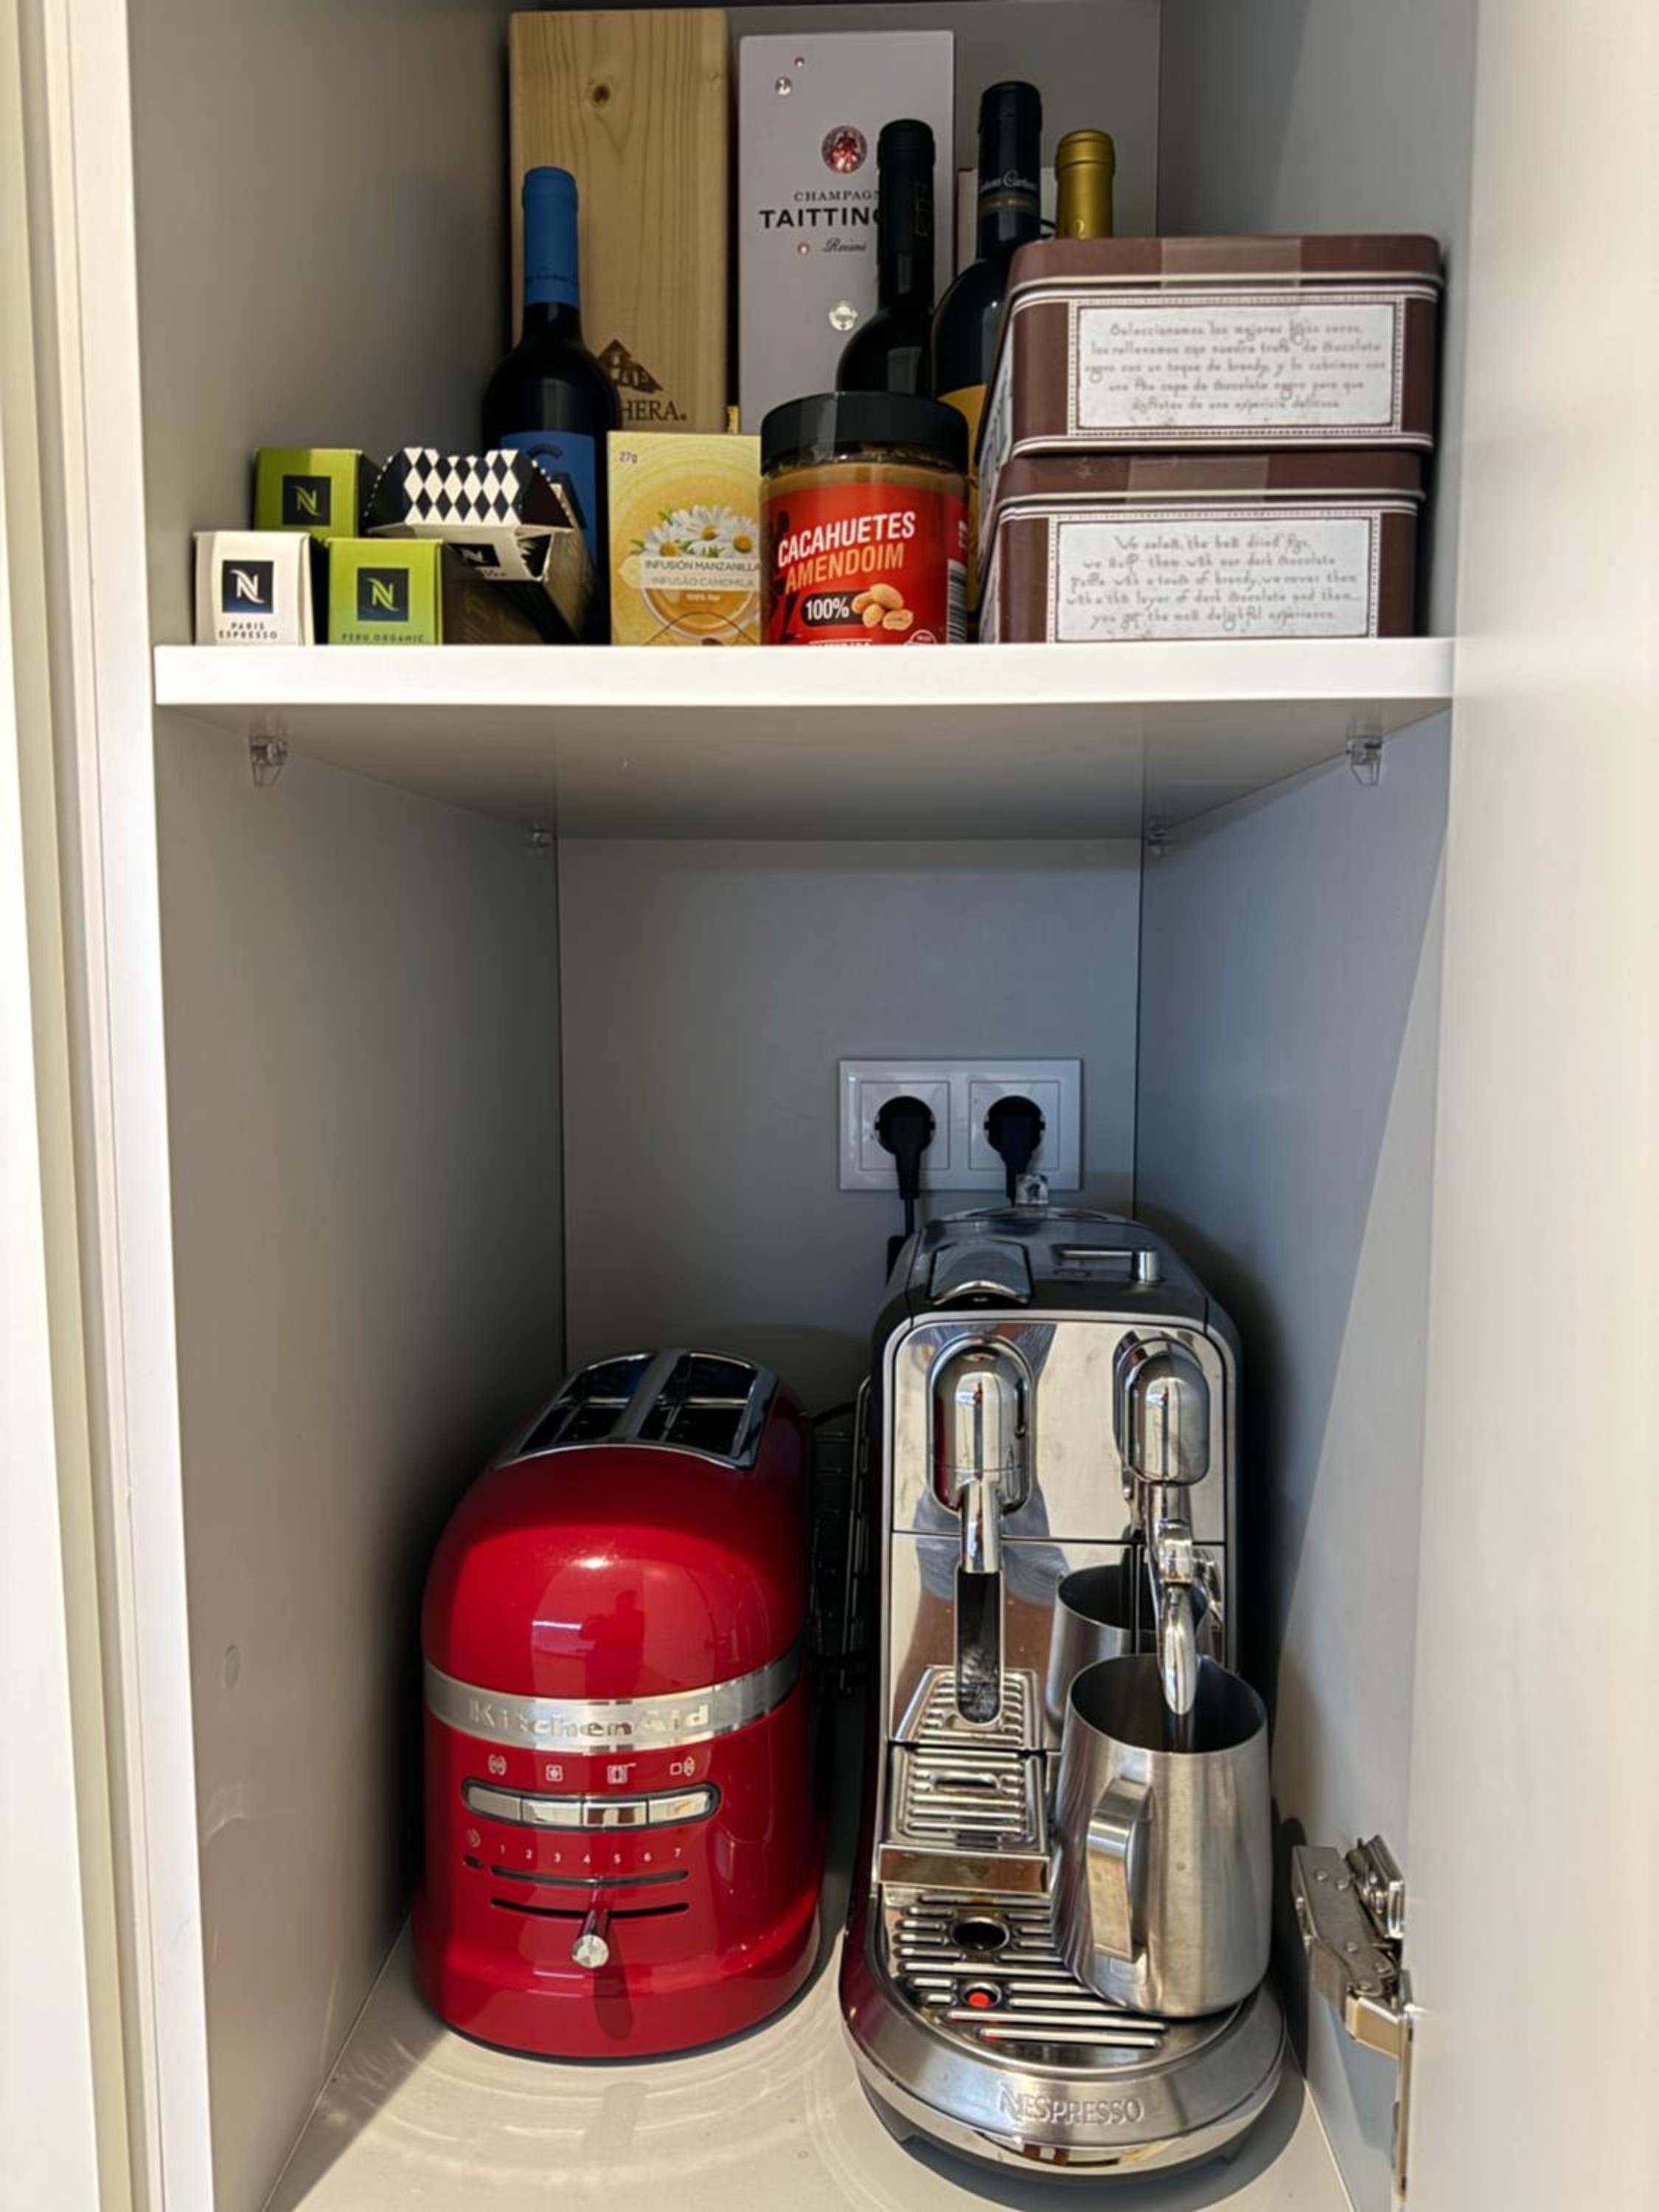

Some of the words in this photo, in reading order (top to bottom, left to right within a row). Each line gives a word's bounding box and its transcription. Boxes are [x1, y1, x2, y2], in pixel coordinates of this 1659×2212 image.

[619, 451, 638, 467] 27g
[778, 510, 917, 568] CACAHUETES
[785, 542, 905, 594] AMENDOIM
[805, 597, 850, 622] 100%
[219, 630, 278, 639] ESPRESSO
[231, 622, 265, 630] PARIS
[341, 633, 369, 642] PERU
[373, 633, 425, 643] ORGANIC
[470, 1698, 709, 1738] KitchenAid
[525, 1848, 533, 1859] 2
[554, 1852, 561, 1863] 3
[582, 1854, 591, 1864] 4
[613, 1854, 622, 1864] 5
[644, 1851, 652, 1862] 6
[674, 1847, 682, 1858] 7
[998, 2080, 1144, 2125] NESPRESSO
